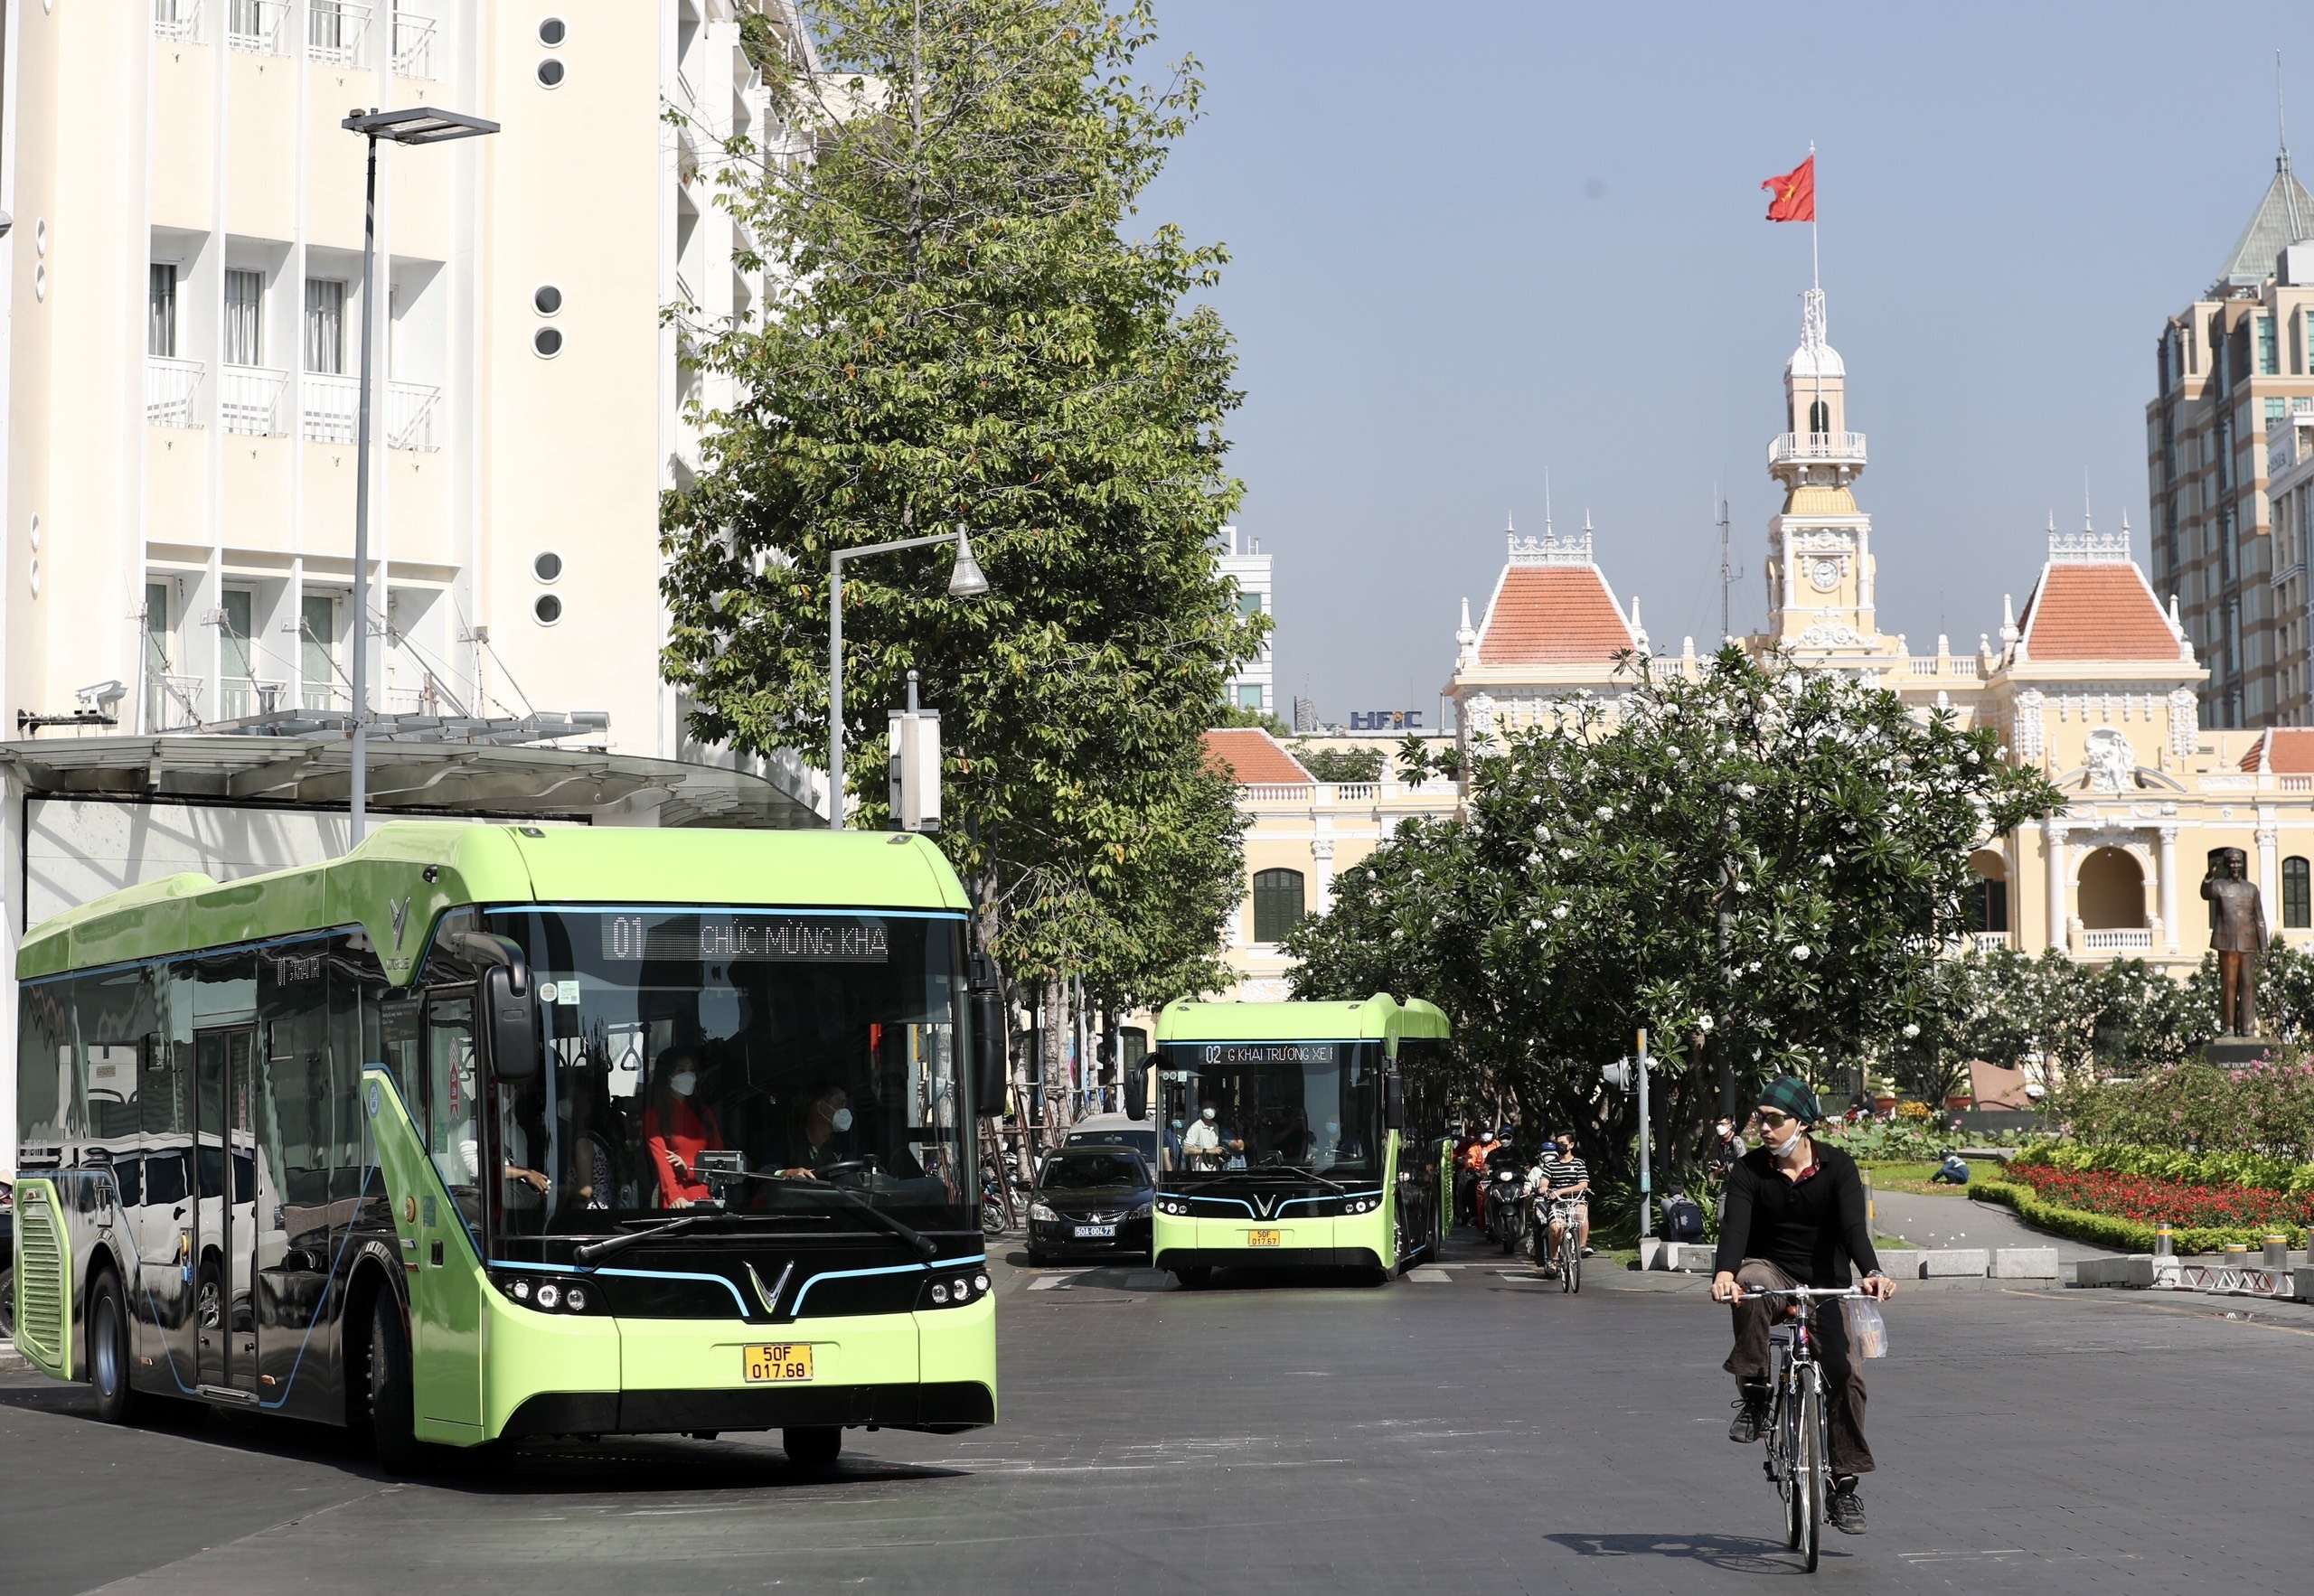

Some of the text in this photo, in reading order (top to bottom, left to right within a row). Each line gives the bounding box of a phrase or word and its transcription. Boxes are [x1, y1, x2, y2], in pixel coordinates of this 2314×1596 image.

[614, 916, 889, 958] 01 CHÚC MỪNG KHA
[1206, 1046, 1221, 1064] 02
[1237, 1047, 1264, 1061] KHAI
[1312, 1047, 1327, 1061] XE
[763, 1346, 792, 1362] 50F
[752, 1362, 805, 1379] 017.68
